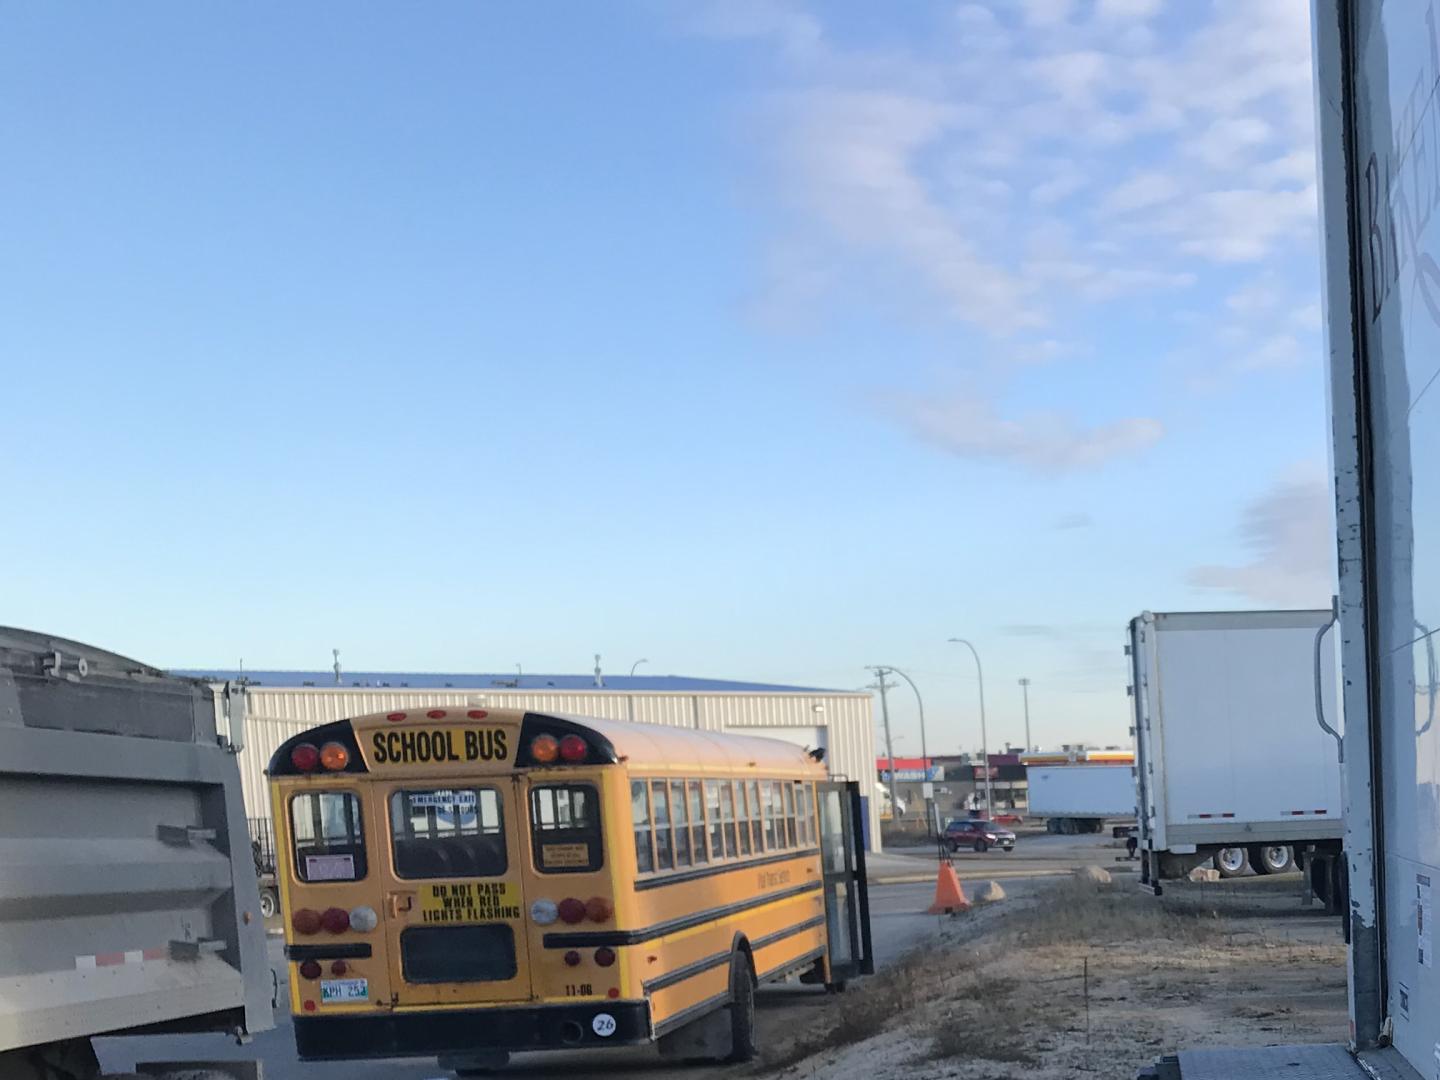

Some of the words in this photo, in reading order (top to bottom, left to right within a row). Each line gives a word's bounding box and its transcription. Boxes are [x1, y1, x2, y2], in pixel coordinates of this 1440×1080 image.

[373, 731, 460, 763] SCHOOL
[464, 729, 508, 761] BUS
[432, 885, 447, 897] DO
[451, 884, 472, 896] NOT
[477, 883, 506, 895] PASS
[443, 897, 473, 908] WHEN
[479, 895, 500, 906] RED
[422, 909, 462, 921] LIGHTS
[467, 906, 520, 920] FLASHING
[597, 1018, 614, 1031] 26
